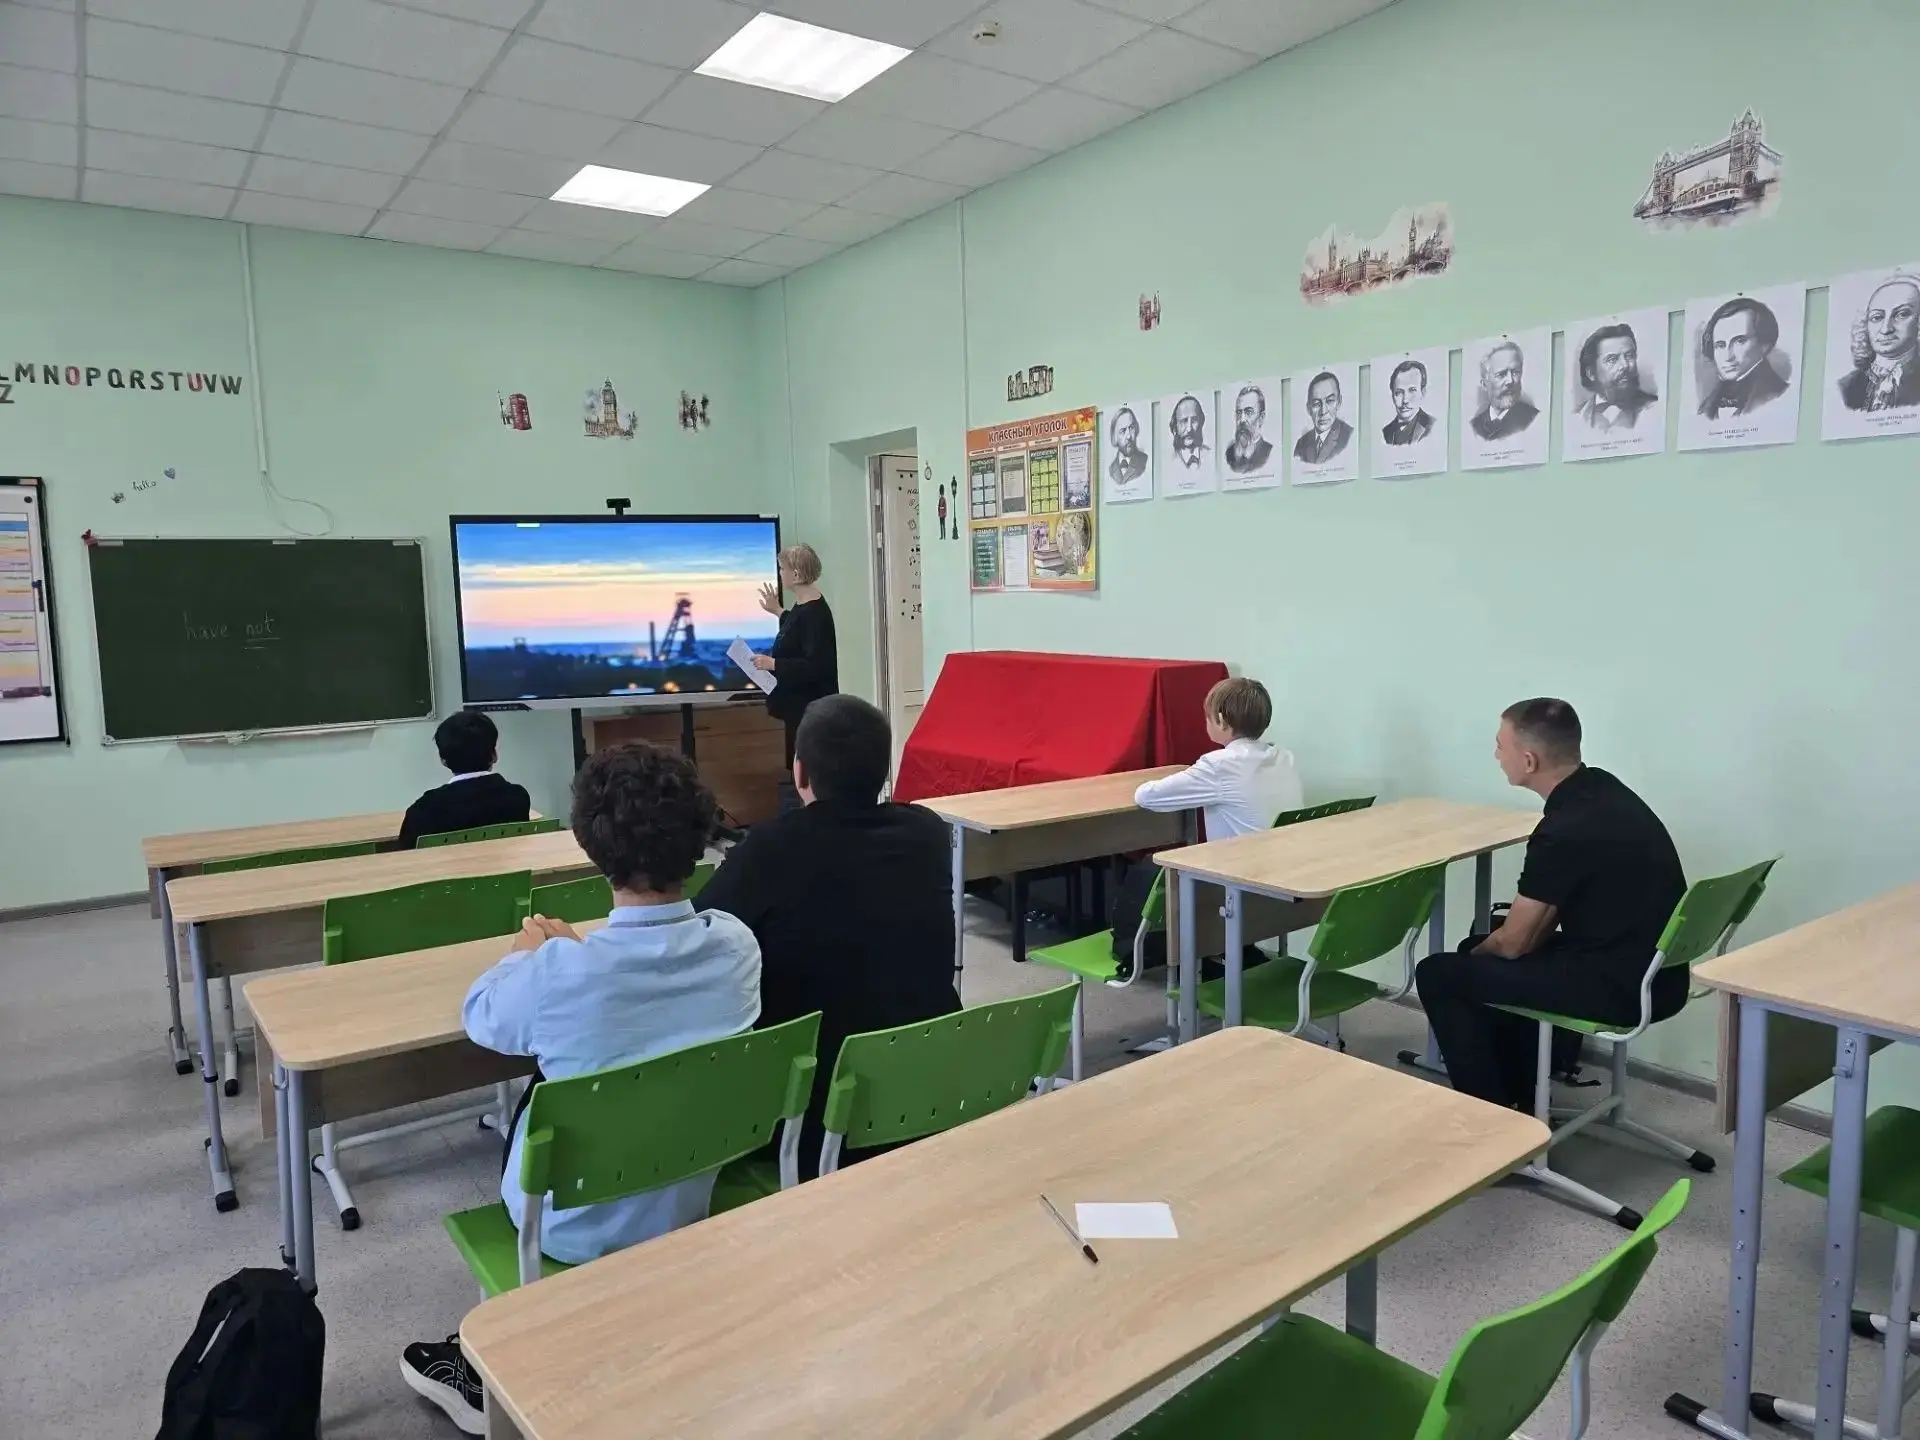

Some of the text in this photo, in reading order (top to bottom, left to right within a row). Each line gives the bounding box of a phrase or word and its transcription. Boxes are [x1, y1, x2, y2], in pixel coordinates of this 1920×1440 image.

[988, 418, 1068, 443] КЛАССНЫЙ УГОЛОК
[183, 608, 275, 641] have not
